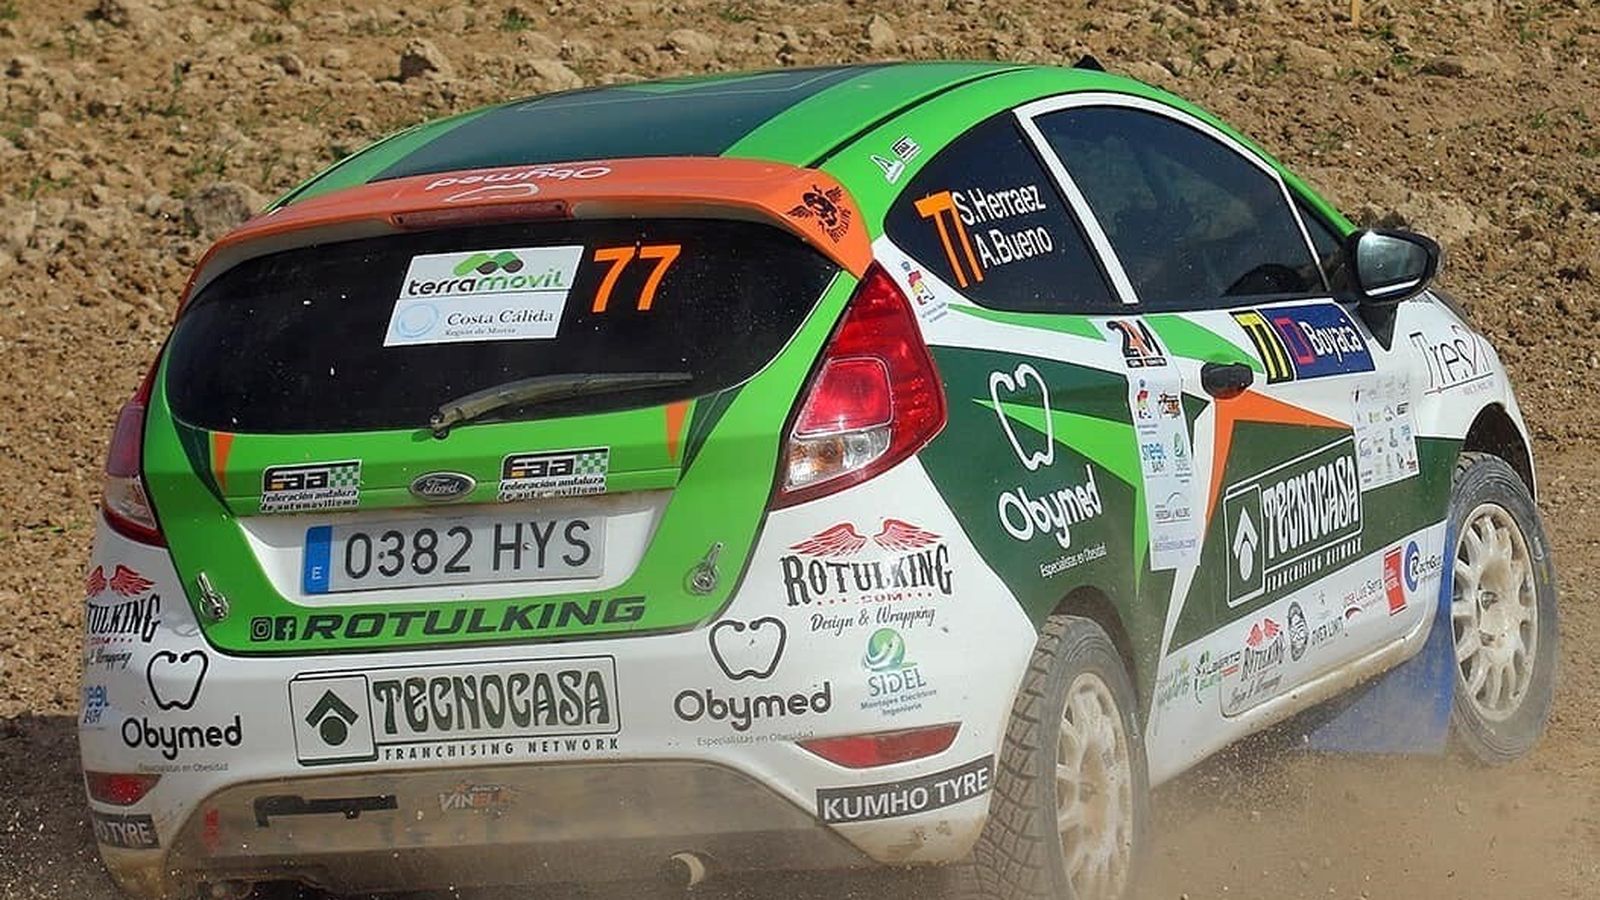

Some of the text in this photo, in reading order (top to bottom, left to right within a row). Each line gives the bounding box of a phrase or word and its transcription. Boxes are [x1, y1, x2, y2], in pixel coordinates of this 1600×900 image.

[953, 184, 1046, 227] S.Herraez
[913, 190, 985, 288] 77
[975, 227, 1053, 268] A.Bueno
[408, 268, 565, 297] terramovil
[592, 244, 681, 312] 77
[447, 309, 555, 326] Costa Cálida
[1233, 313, 1289, 379] 77
[998, 464, 1102, 549] Obymed
[1263, 455, 1359, 559] TECNOCASA
[345, 519, 593, 581] 0382 HYS
[779, 543, 953, 607] ROTULKING
[303, 597, 645, 640] ROTULKING
[811, 605, 935, 637] Design & Wrapping
[373, 670, 610, 735] TECNOCASA
[674, 681, 831, 731] Obymed
[868, 667, 927, 697] SIDEL
[122, 715, 242, 760] Obymed
[385, 737, 620, 760] FRANCHISING NETWORK
[823, 767, 990, 820] KUMHO TYRE
